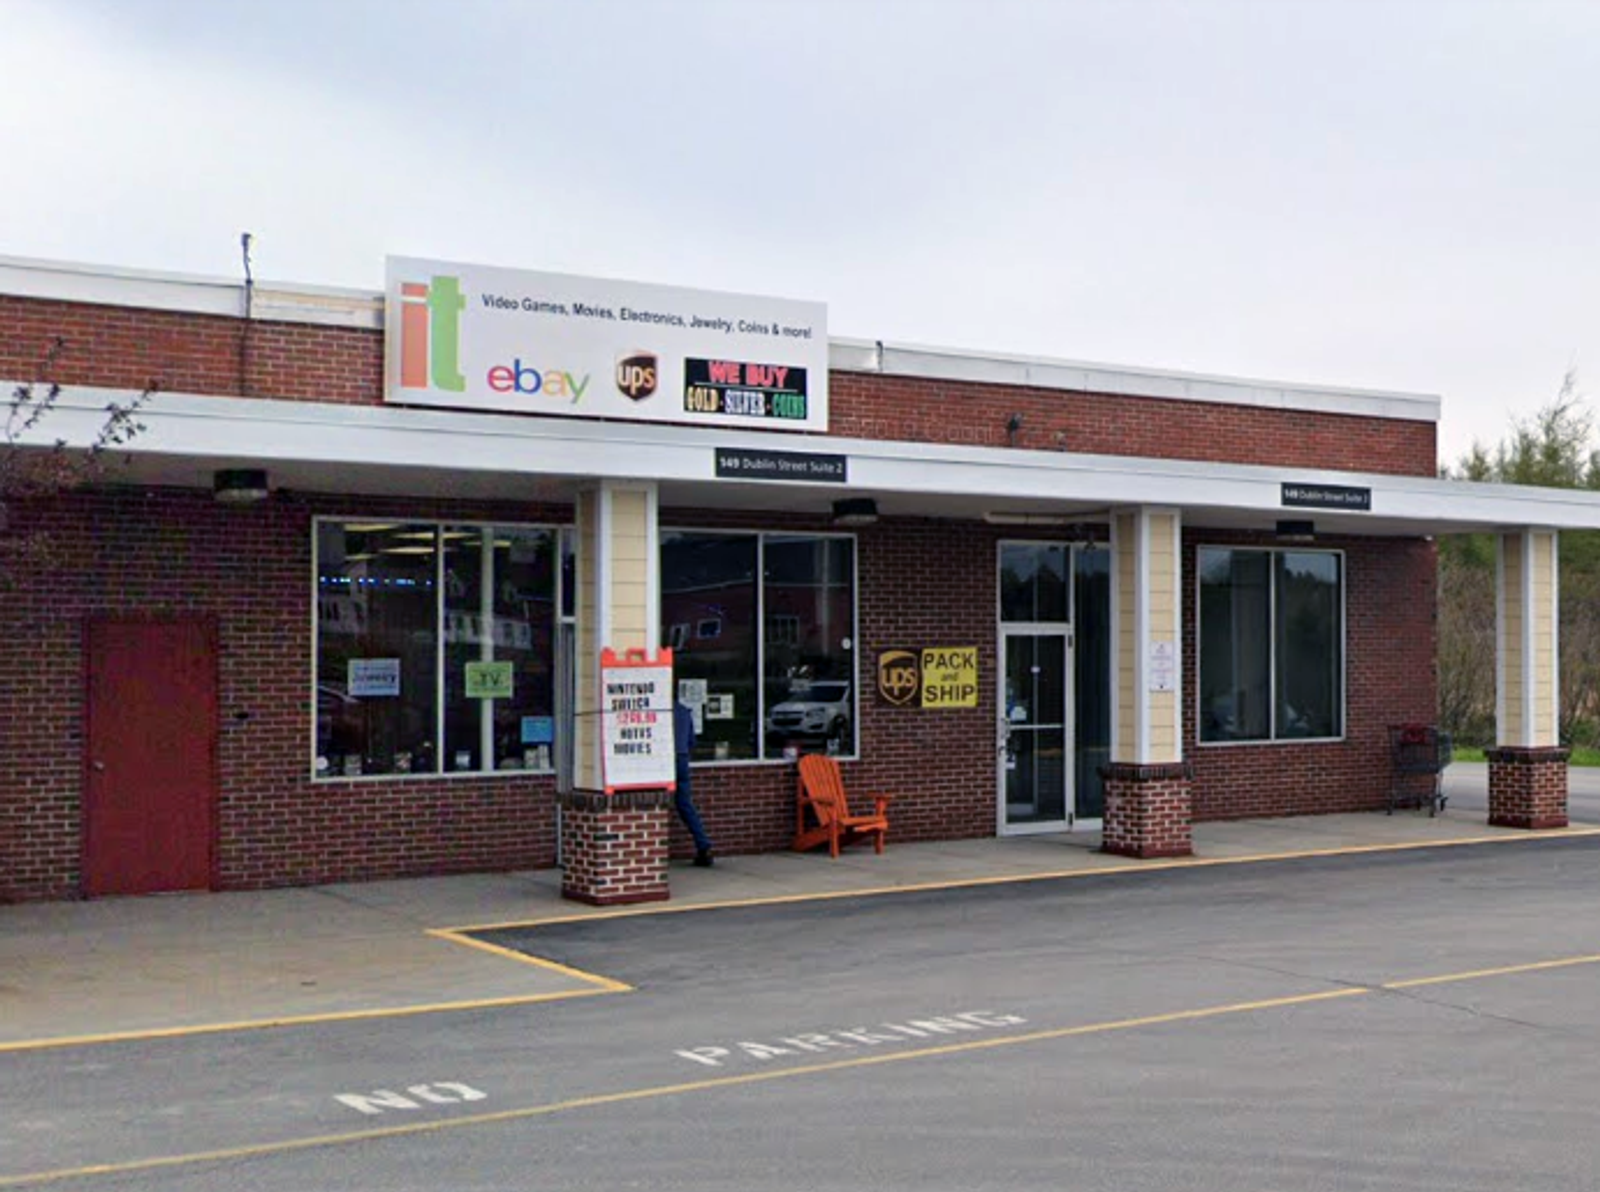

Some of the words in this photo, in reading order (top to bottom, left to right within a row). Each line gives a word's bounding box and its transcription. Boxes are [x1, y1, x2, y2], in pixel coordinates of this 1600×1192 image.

[481, 293, 519, 310] Video
[522, 297, 569, 316] Games,
[572, 303, 616, 320] Movies,
[620, 307, 686, 327] Electronics,
[690, 314, 735, 334] Jewelry,
[738, 319, 769, 335] Coins
[772, 322, 780, 336] &
[782, 325, 812, 339] more!
[400, 275, 466, 392] it
[487, 358, 590, 404] ebay
[617, 367, 655, 395] ups
[708, 360, 741, 384] WE
[745, 363, 788, 389] BUY
[687, 386, 719, 411] GOLD
[724, 389, 766, 415] SILVER
[742, 458, 777, 470] Dublin
[778, 459, 807, 471] Street
[810, 461, 835, 473] Suite
[836, 462, 843, 474] 2
[923, 652, 975, 670] PACK
[479, 672, 500, 686] TV
[606, 681, 655, 695] NINTENDO
[881, 667, 918, 696] ups
[941, 672, 959, 682] and
[611, 696, 650, 712] SWITCH
[924, 684, 976, 703] SHIP
[332, 1080, 488, 1116] NO
[674, 1010, 1029, 1067] PARKING
